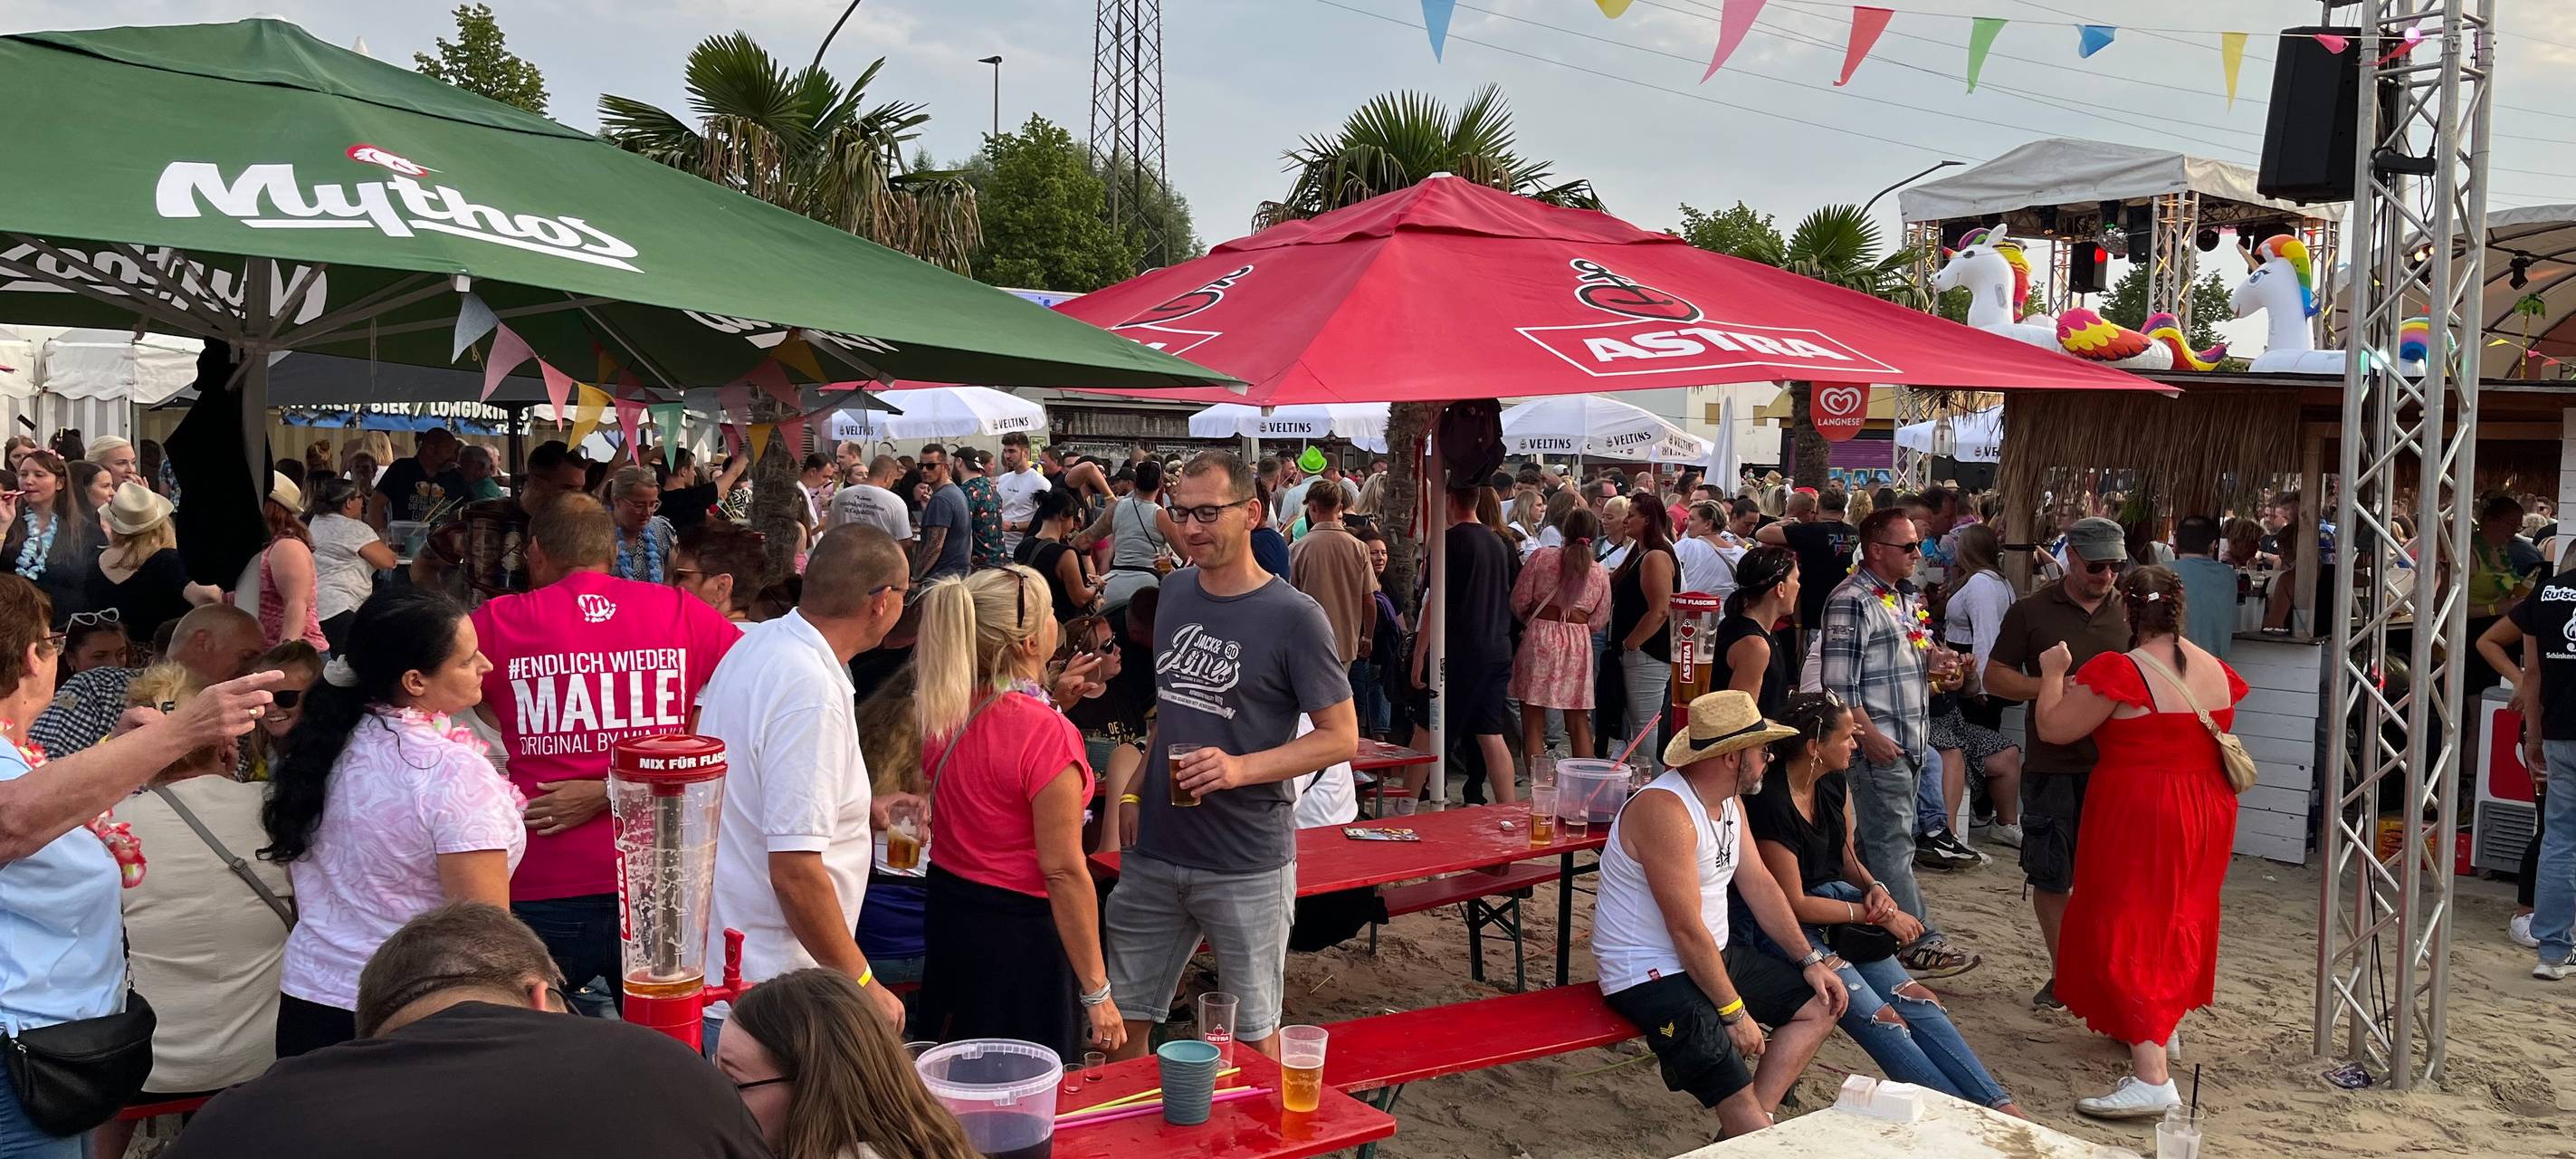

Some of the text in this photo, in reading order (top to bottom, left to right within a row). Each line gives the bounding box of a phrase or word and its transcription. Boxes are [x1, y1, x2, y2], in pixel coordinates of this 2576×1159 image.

[156, 161, 639, 259] Mythos
[1583, 327, 1855, 361] ASTRA
[430, 401, 529, 420] LONGDRINS
[998, 417, 1029, 429] VELTINS
[1269, 422, 1312, 433] VELTINS
[1818, 417, 1860, 426] LANGNESE
[846, 426, 874, 436] VELTINS
[1614, 431, 1651, 446] VELTINS
[1530, 438, 1571, 449] VELTINS
[1674, 435, 1694, 453] VELTINS
[1194, 634, 1223, 654] JACK&
[508, 648, 679, 679] #ENDLICH WIEDER
[1156, 623, 1241, 687] Jones
[510, 648, 687, 735] MALLE!
[520, 734, 592, 755] ORIGINAL
[597, 732, 619, 752] BY
[639, 758, 665, 770] NIX
[669, 756, 697, 769] FÜR
